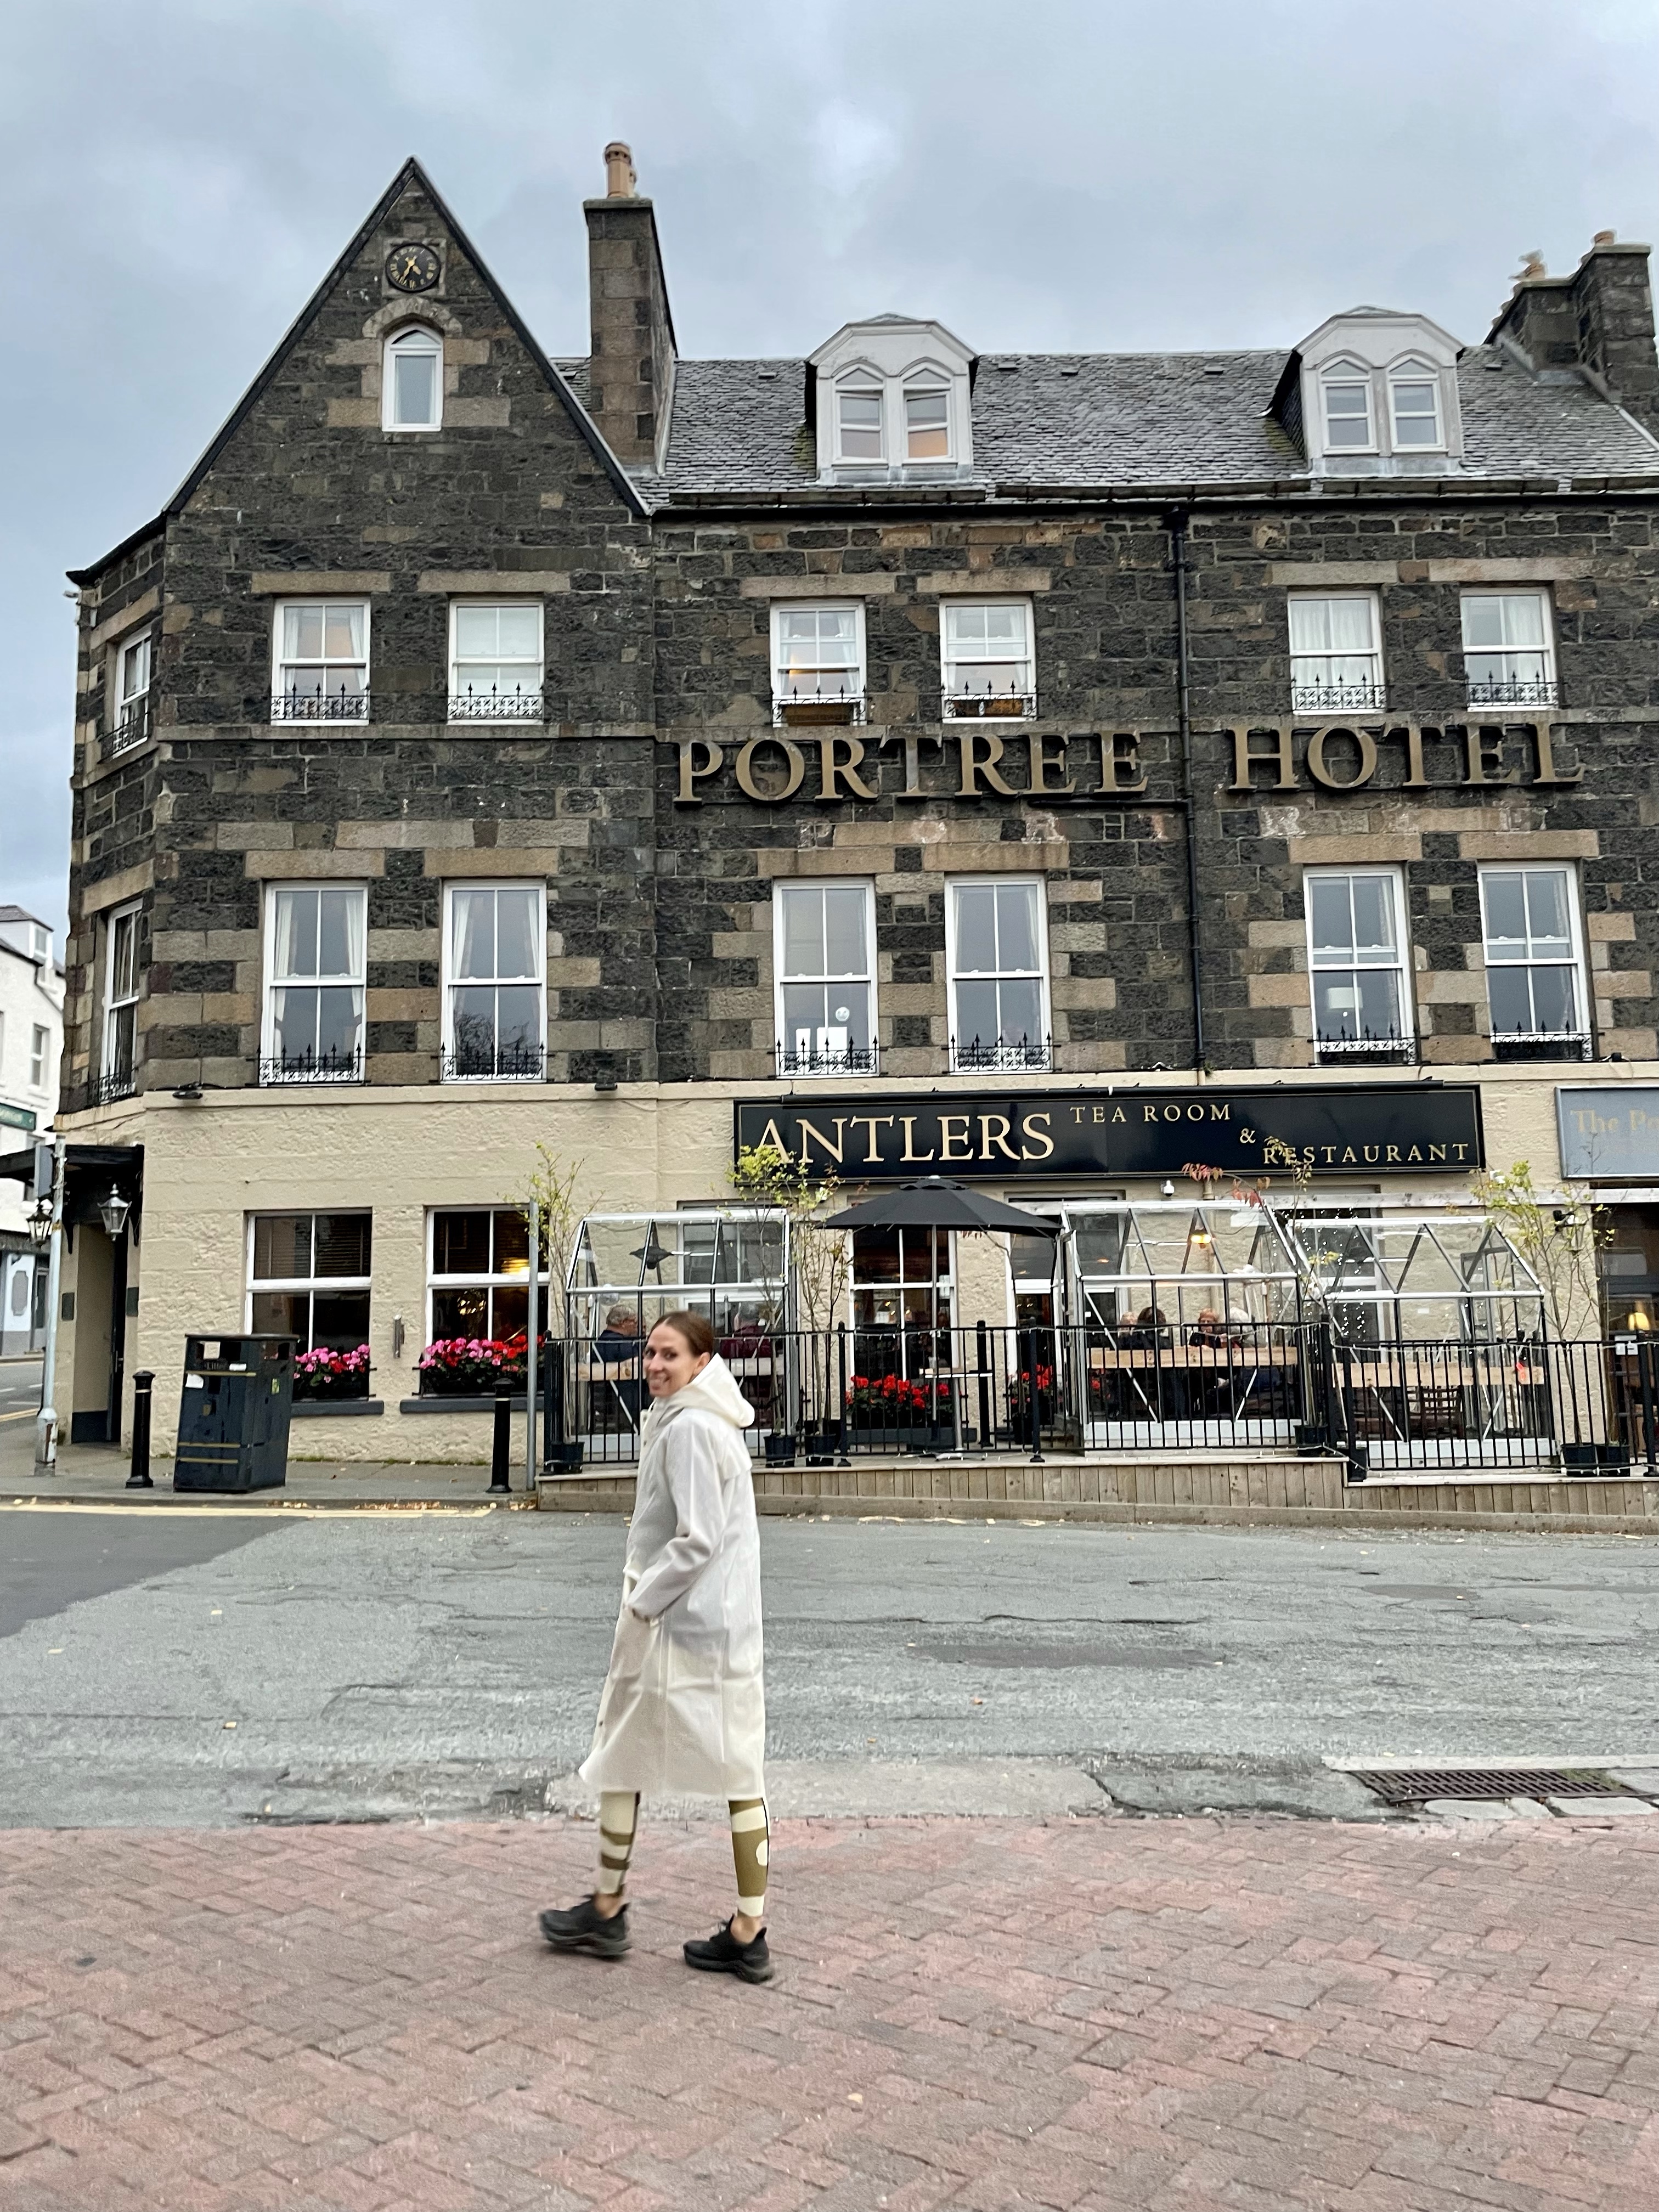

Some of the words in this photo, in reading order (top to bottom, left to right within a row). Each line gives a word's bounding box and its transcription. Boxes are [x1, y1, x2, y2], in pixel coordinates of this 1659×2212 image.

[673, 730, 1149, 802] PORTREE
[1228, 723, 1585, 790] HOTEL
[1070, 1104, 1127, 1124] TEA
[1143, 1104, 1231, 1122] ROOM
[1570, 1109, 1620, 1133] The
[754, 1113, 1055, 1164] ANTLERS
[1239, 1128, 1256, 1144] &
[1262, 1142, 1470, 1165] RESTAURANT
